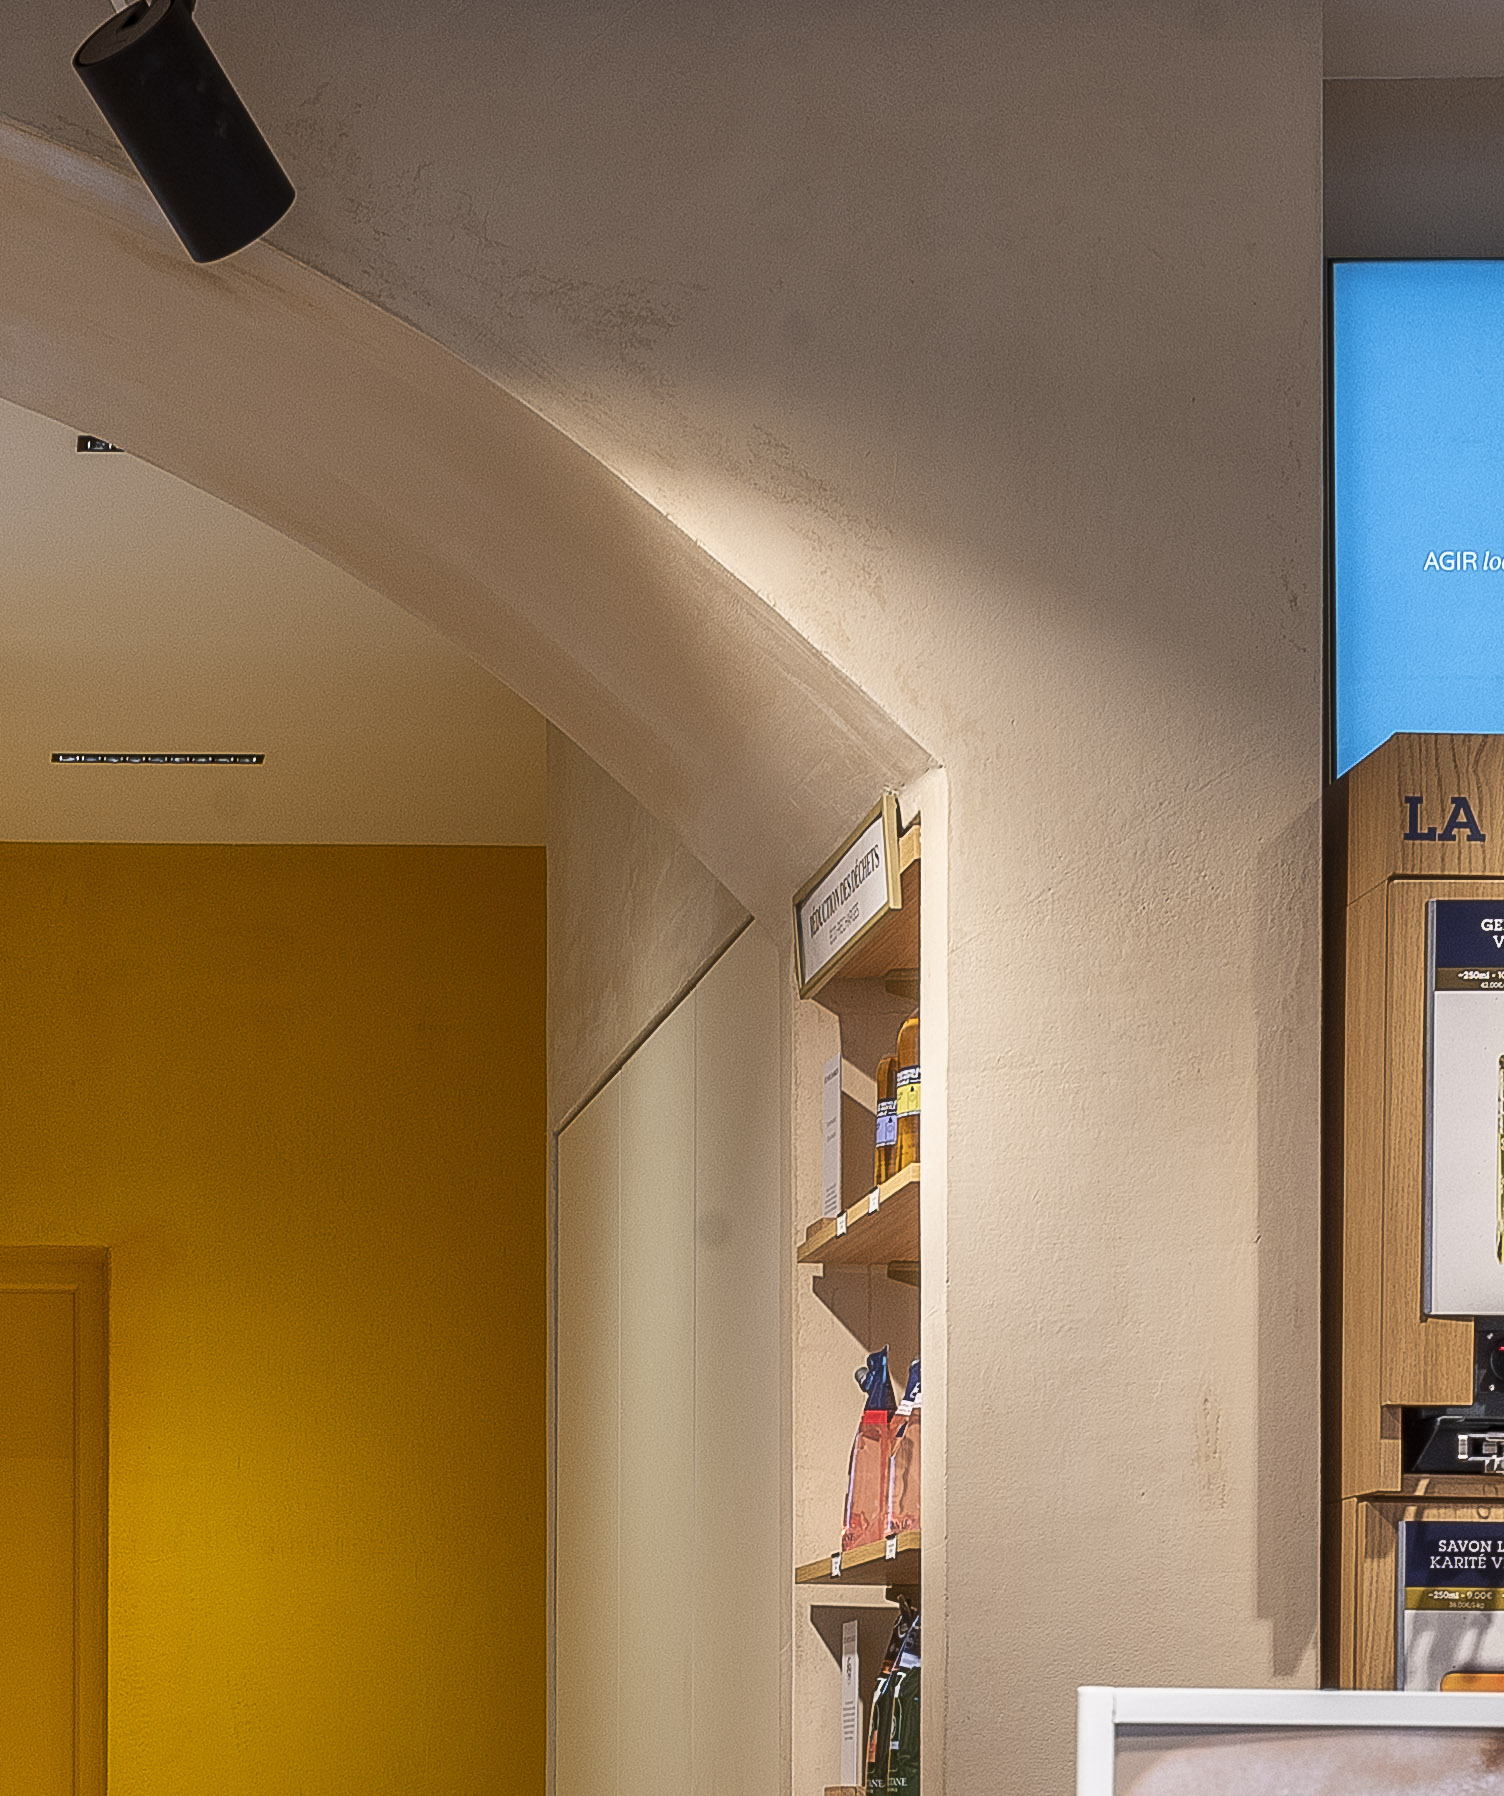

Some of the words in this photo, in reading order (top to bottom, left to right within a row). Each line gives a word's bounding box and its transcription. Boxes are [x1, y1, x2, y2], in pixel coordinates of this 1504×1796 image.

[1423, 550, 1478, 571] AGIR
[1402, 795, 1486, 843] LA
[1438, 1540, 1491, 1553] SAVON
[1429, 1555, 1487, 1570] KARITÉ
